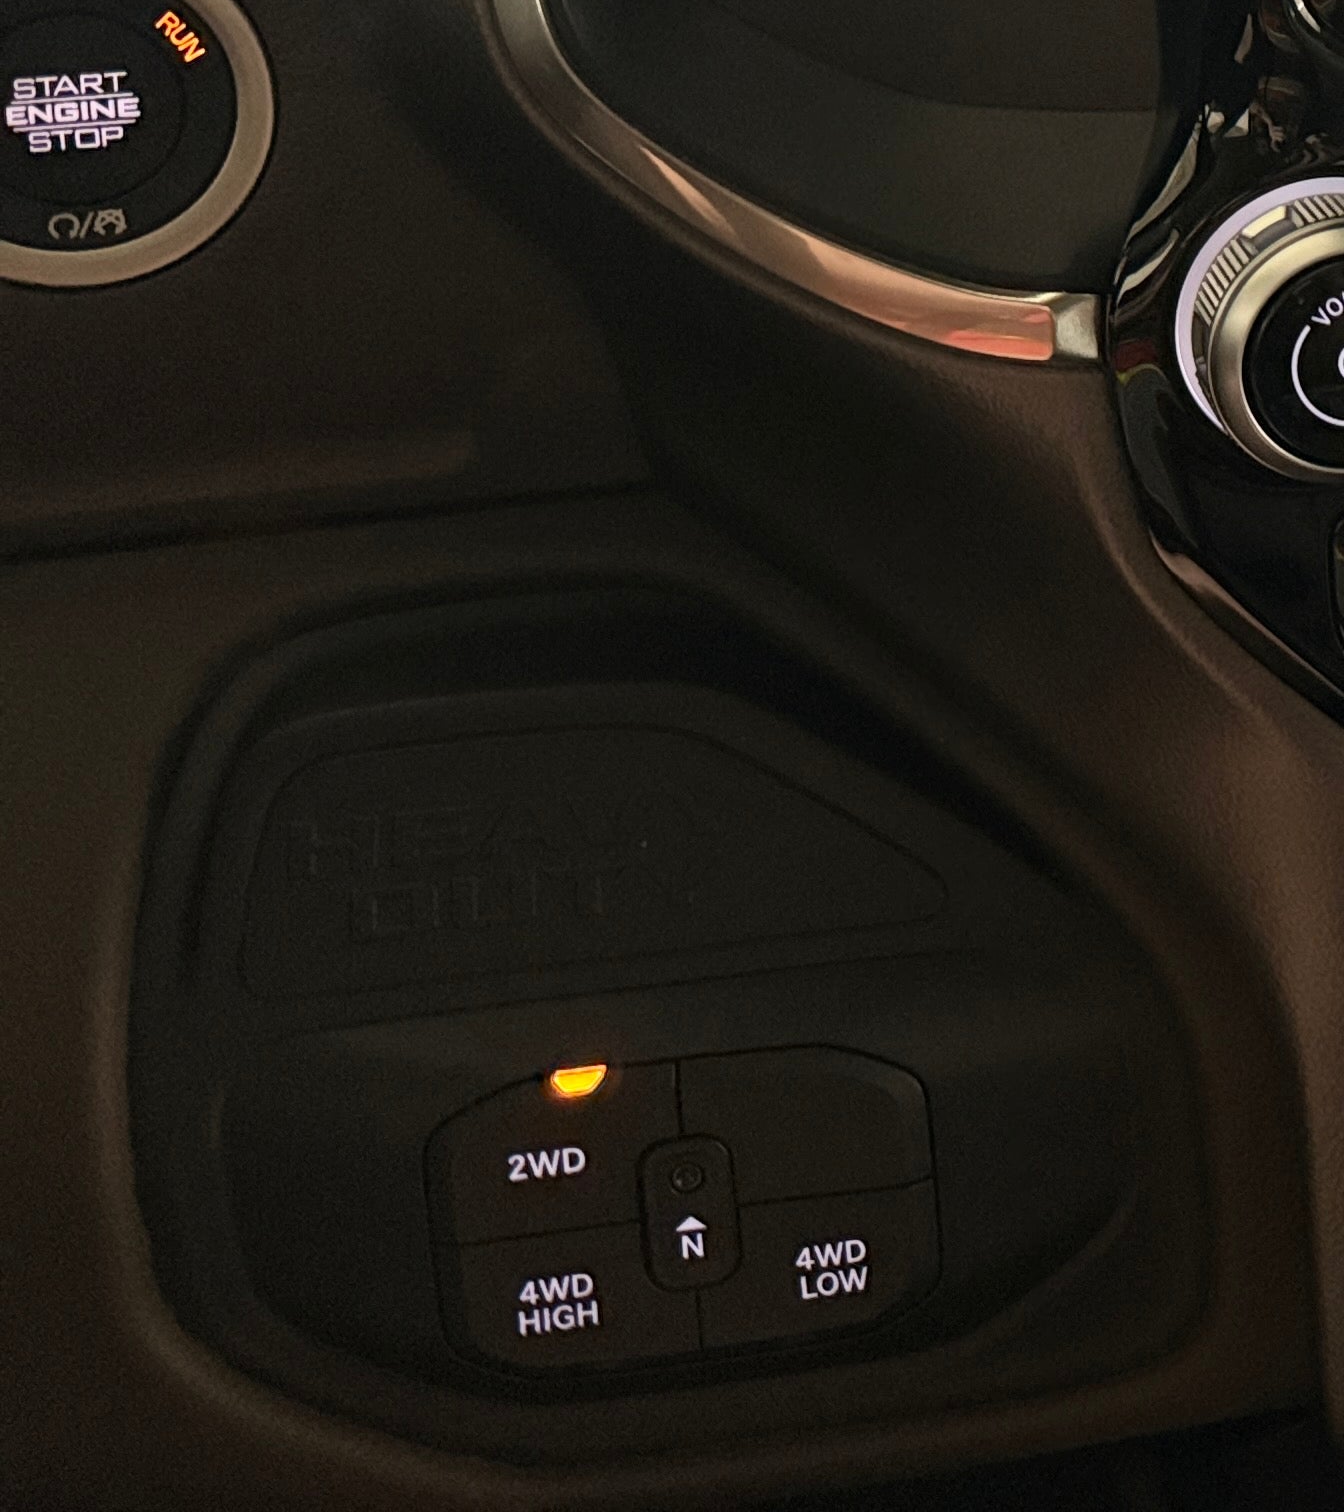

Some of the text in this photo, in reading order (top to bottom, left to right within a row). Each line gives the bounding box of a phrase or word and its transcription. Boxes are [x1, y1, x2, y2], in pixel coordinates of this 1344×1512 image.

[155, 10, 206, 63] RUN
[13, 71, 128, 99] START
[6, 97, 142, 127] ENGINE
[28, 125, 125, 153] STOP
[507, 1147, 587, 1182] 2WD
[681, 1234, 705, 1260] N
[795, 1239, 867, 1271] 4WD
[519, 1273, 594, 1305] 4WD
[800, 1267, 868, 1301] LOW
[518, 1302, 600, 1338] HIGH
